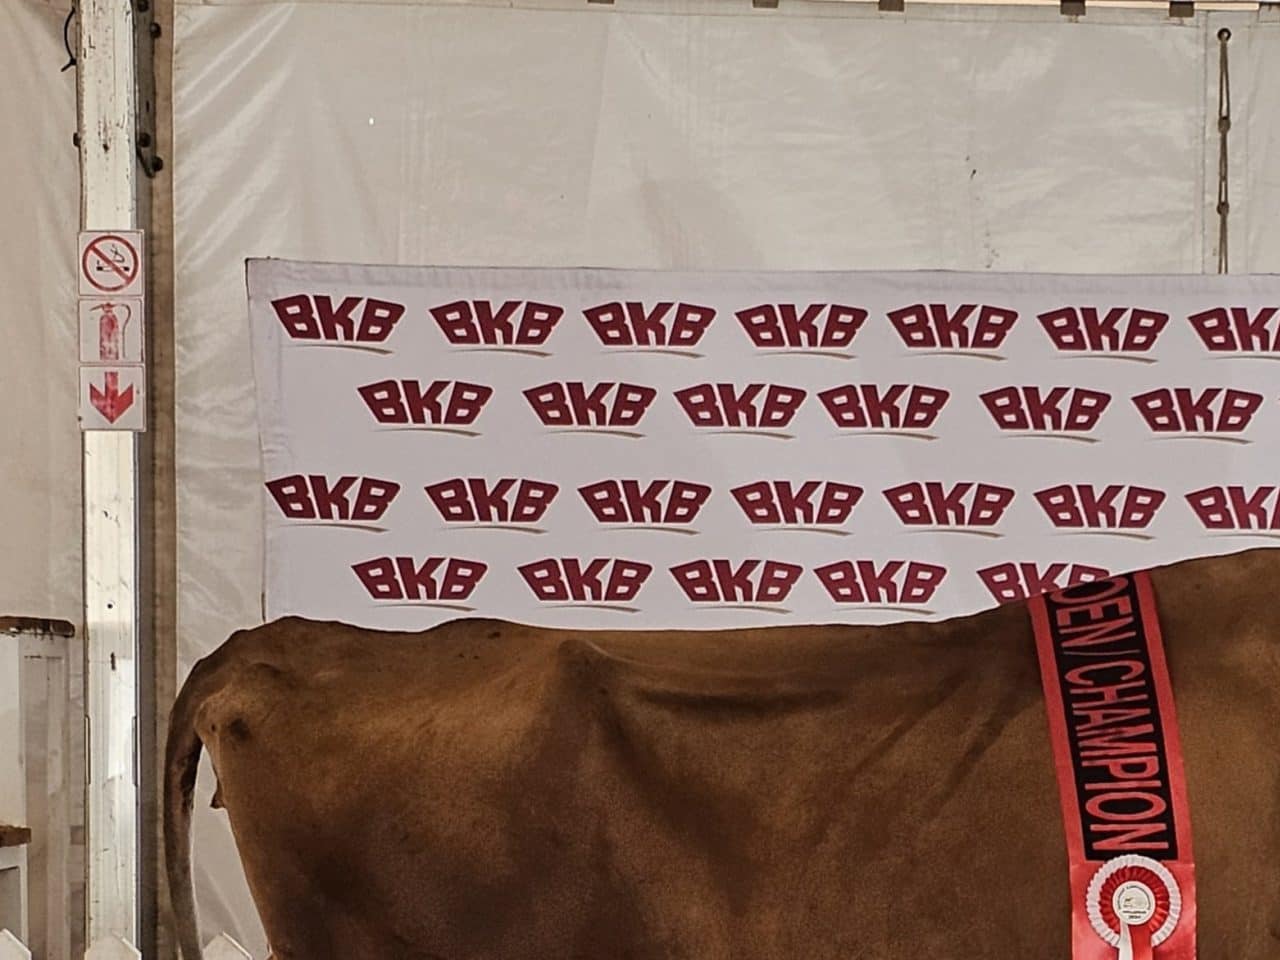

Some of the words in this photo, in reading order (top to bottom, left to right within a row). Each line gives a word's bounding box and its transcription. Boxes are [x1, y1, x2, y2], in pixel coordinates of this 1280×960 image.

[272, 294, 404, 341] BKB
[429, 299, 564, 344] BKB
[583, 302, 716, 345] BKB
[734, 302, 867, 346] BKB
[887, 302, 1018, 348] BKB
[1037, 306, 1169, 351] BKB
[356, 378, 493, 424] BKB
[523, 381, 657, 425] BKB
[672, 382, 808, 427] BKB
[815, 383, 950, 428] BKB
[979, 385, 1110, 430] BKB
[1130, 387, 1262, 431] BKB
[264, 473, 400, 520] BKB
[424, 477, 559, 522] BKB
[577, 478, 710, 522] BKB
[729, 479, 863, 523] BKB
[881, 480, 1015, 525] BKB
[1033, 483, 1165, 527] BKB
[351, 554, 488, 599] BKB
[517, 556, 652, 600] BKB
[668, 558, 805, 602] BKB
[811, 559, 947, 603] BKB
[1065, 660, 1169, 851] CHAMPION
